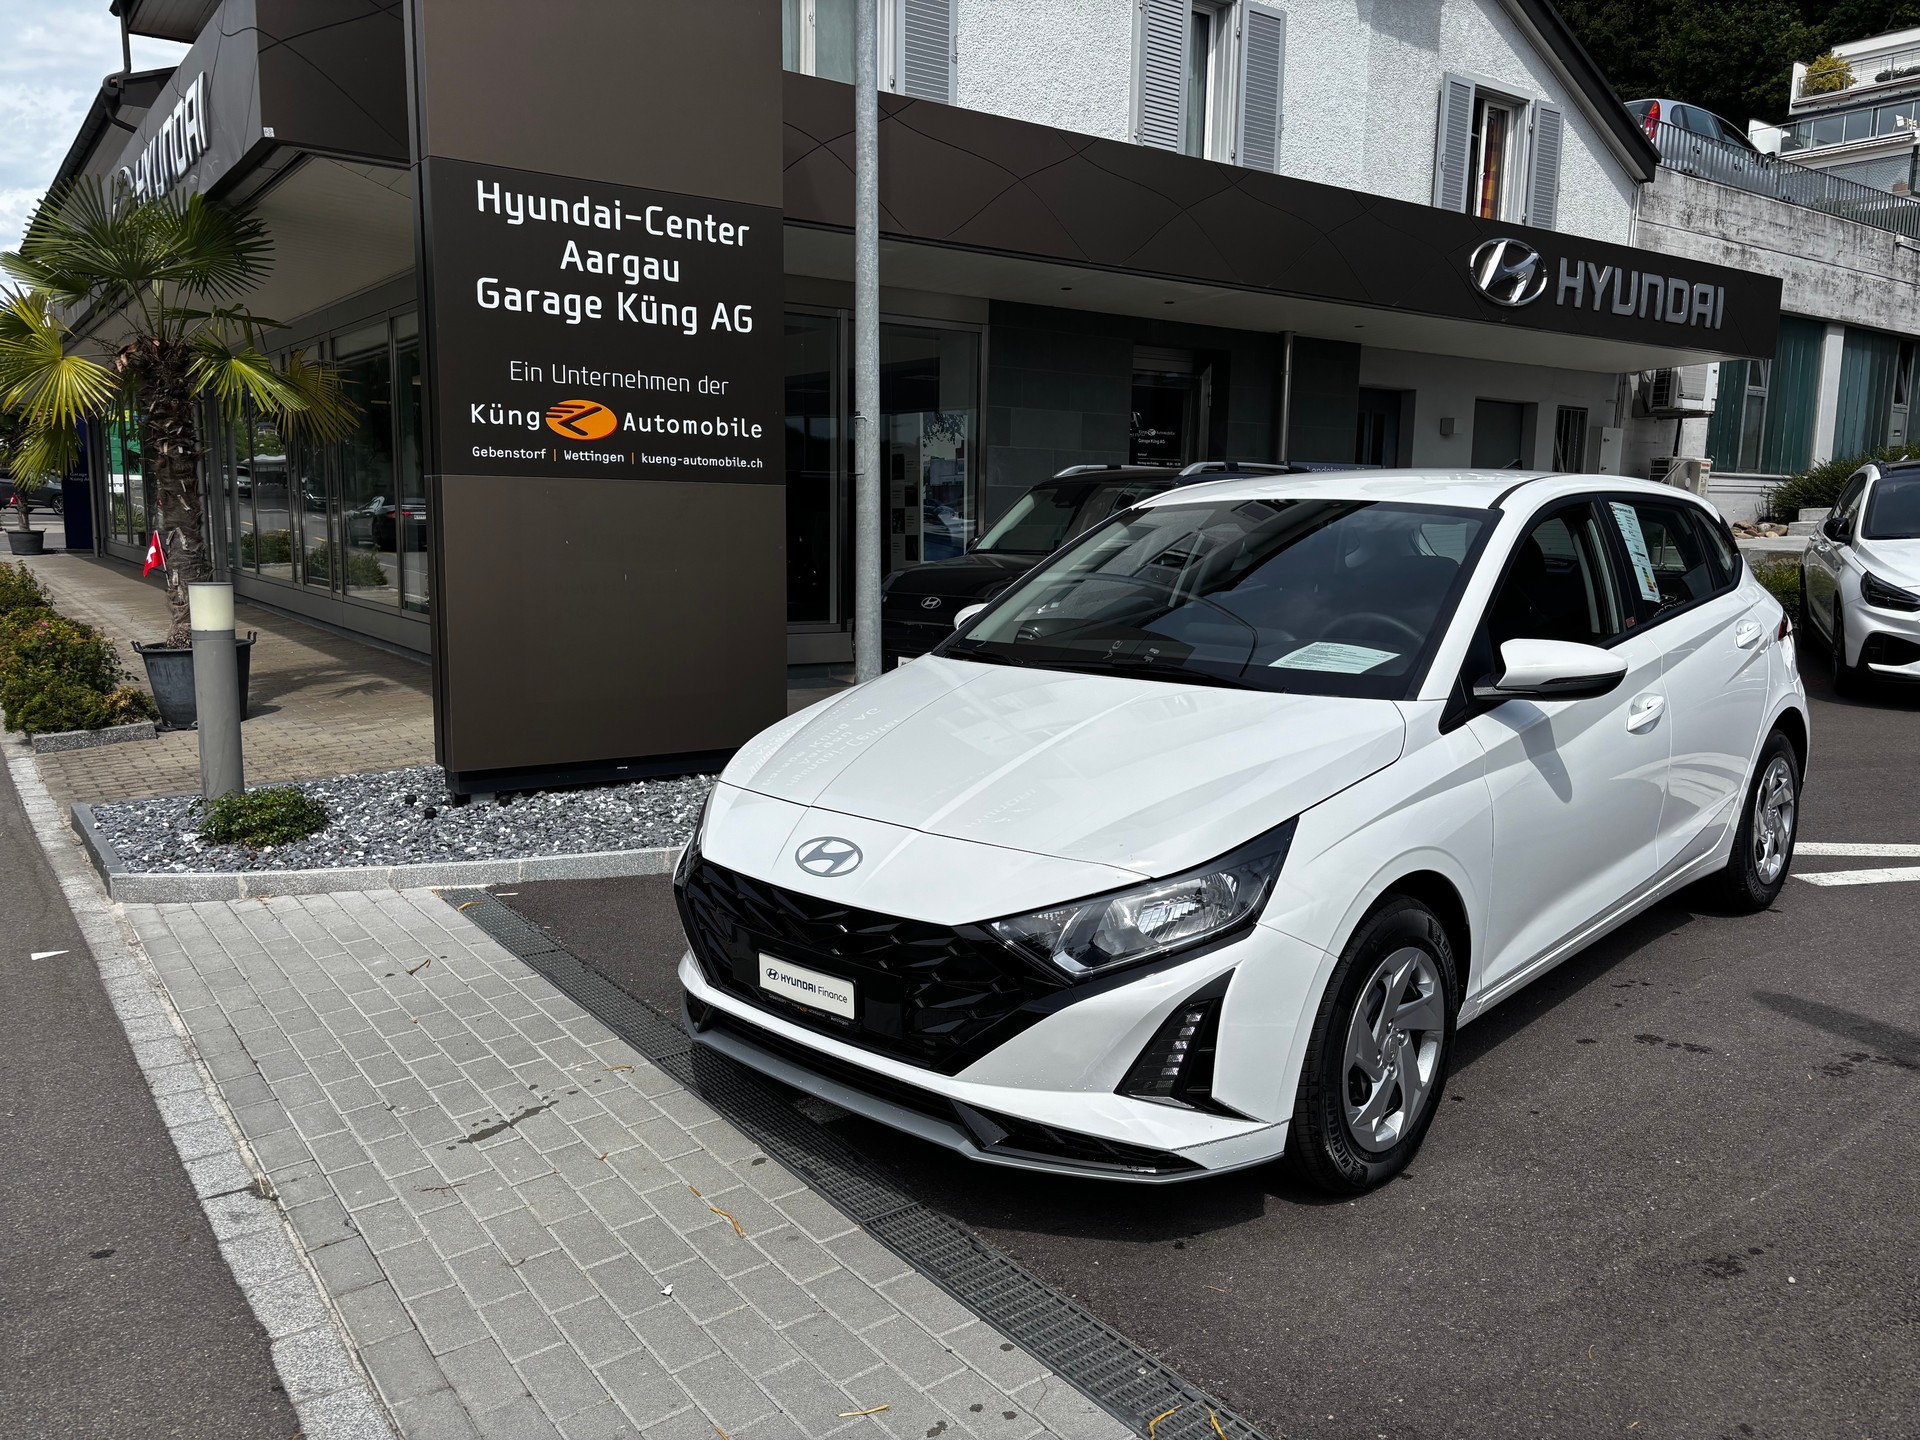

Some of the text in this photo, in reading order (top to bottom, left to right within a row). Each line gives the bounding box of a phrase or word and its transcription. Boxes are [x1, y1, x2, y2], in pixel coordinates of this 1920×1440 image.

[135, 71, 209, 208] HYUNDAI
[476, 179, 750, 247] Hyundai-Center
[560, 240, 680, 285] Aargau
[476, 277, 754, 335] Garage Küng AG
[1556, 257, 1725, 330] HYUNDAI
[510, 360, 730, 395] Ein Unternehmen der
[470, 403, 763, 439] Küng Automobile
[472, 446, 763, 469] Gebenstorf Wettingen kueng-automobile.ch
[780, 973, 848, 1004] HYUNDAI Finance
